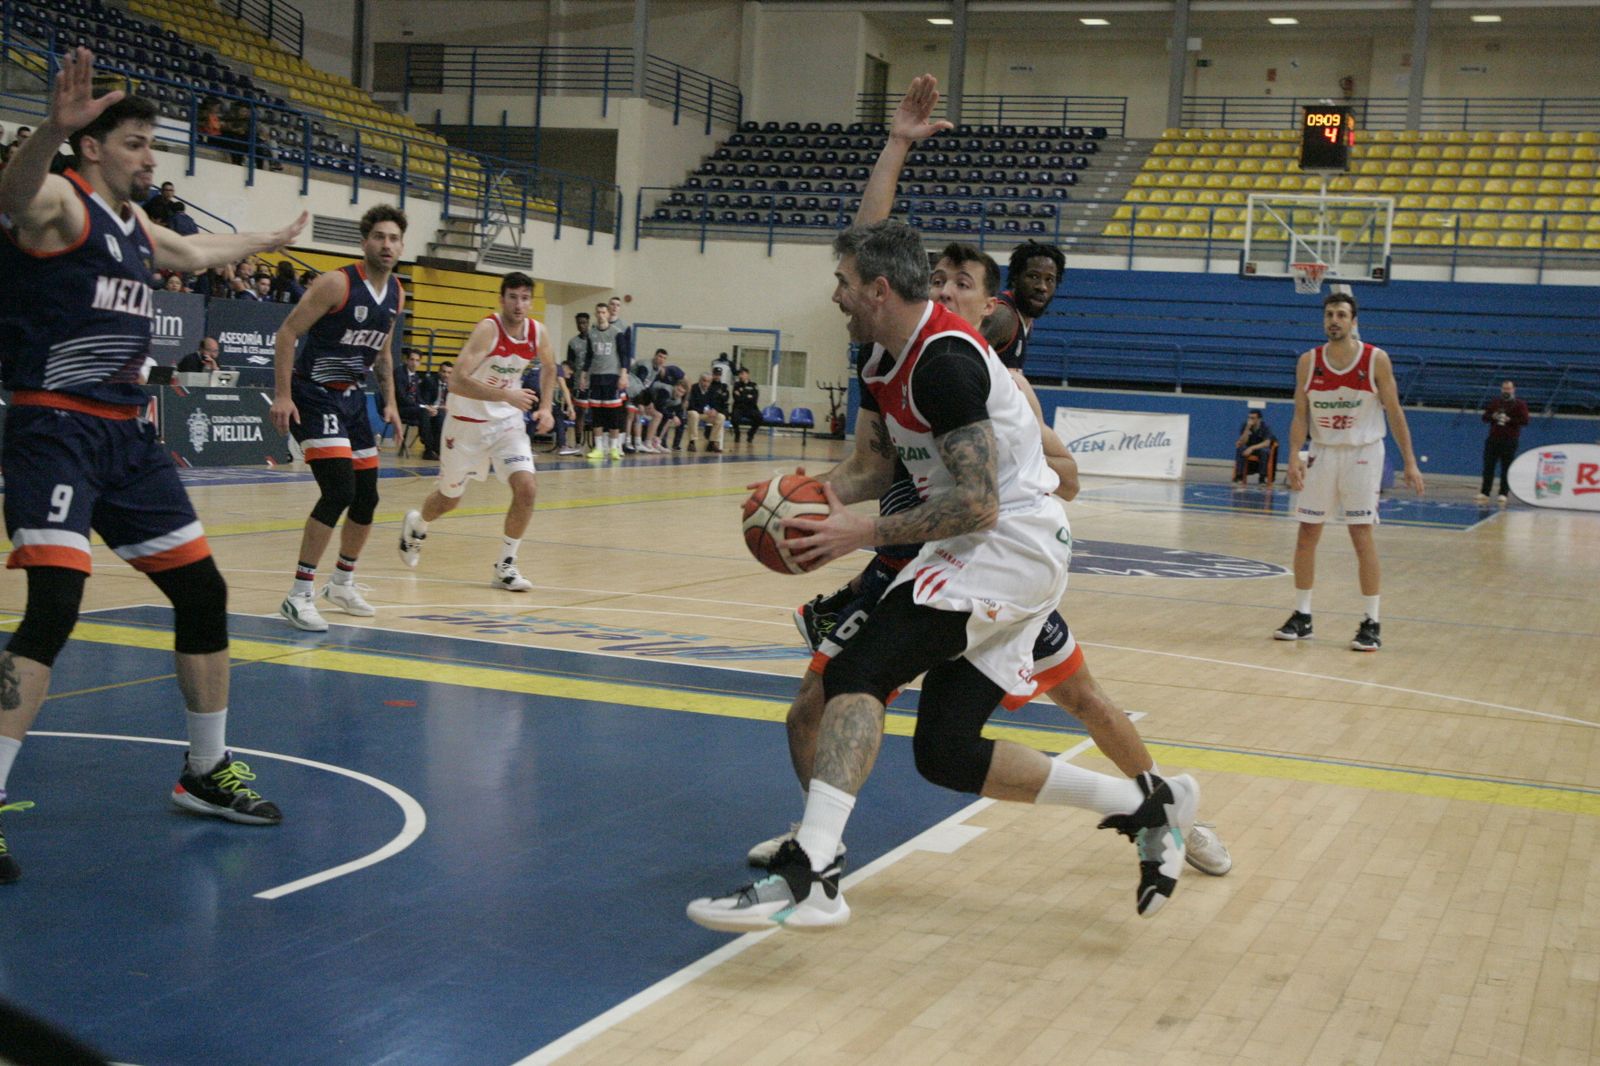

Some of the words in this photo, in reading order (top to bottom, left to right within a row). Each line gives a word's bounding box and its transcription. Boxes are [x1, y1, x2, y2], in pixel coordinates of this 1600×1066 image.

[1325, 128, 1338, 143] 4
[213, 425, 264, 442] MELILLA
[323, 414, 340, 435] 13
[1067, 440, 1106, 453] VEN
[1117, 431, 1171, 451] Melilla
[47, 484, 74, 523] 9
[835, 609, 869, 641] 6
